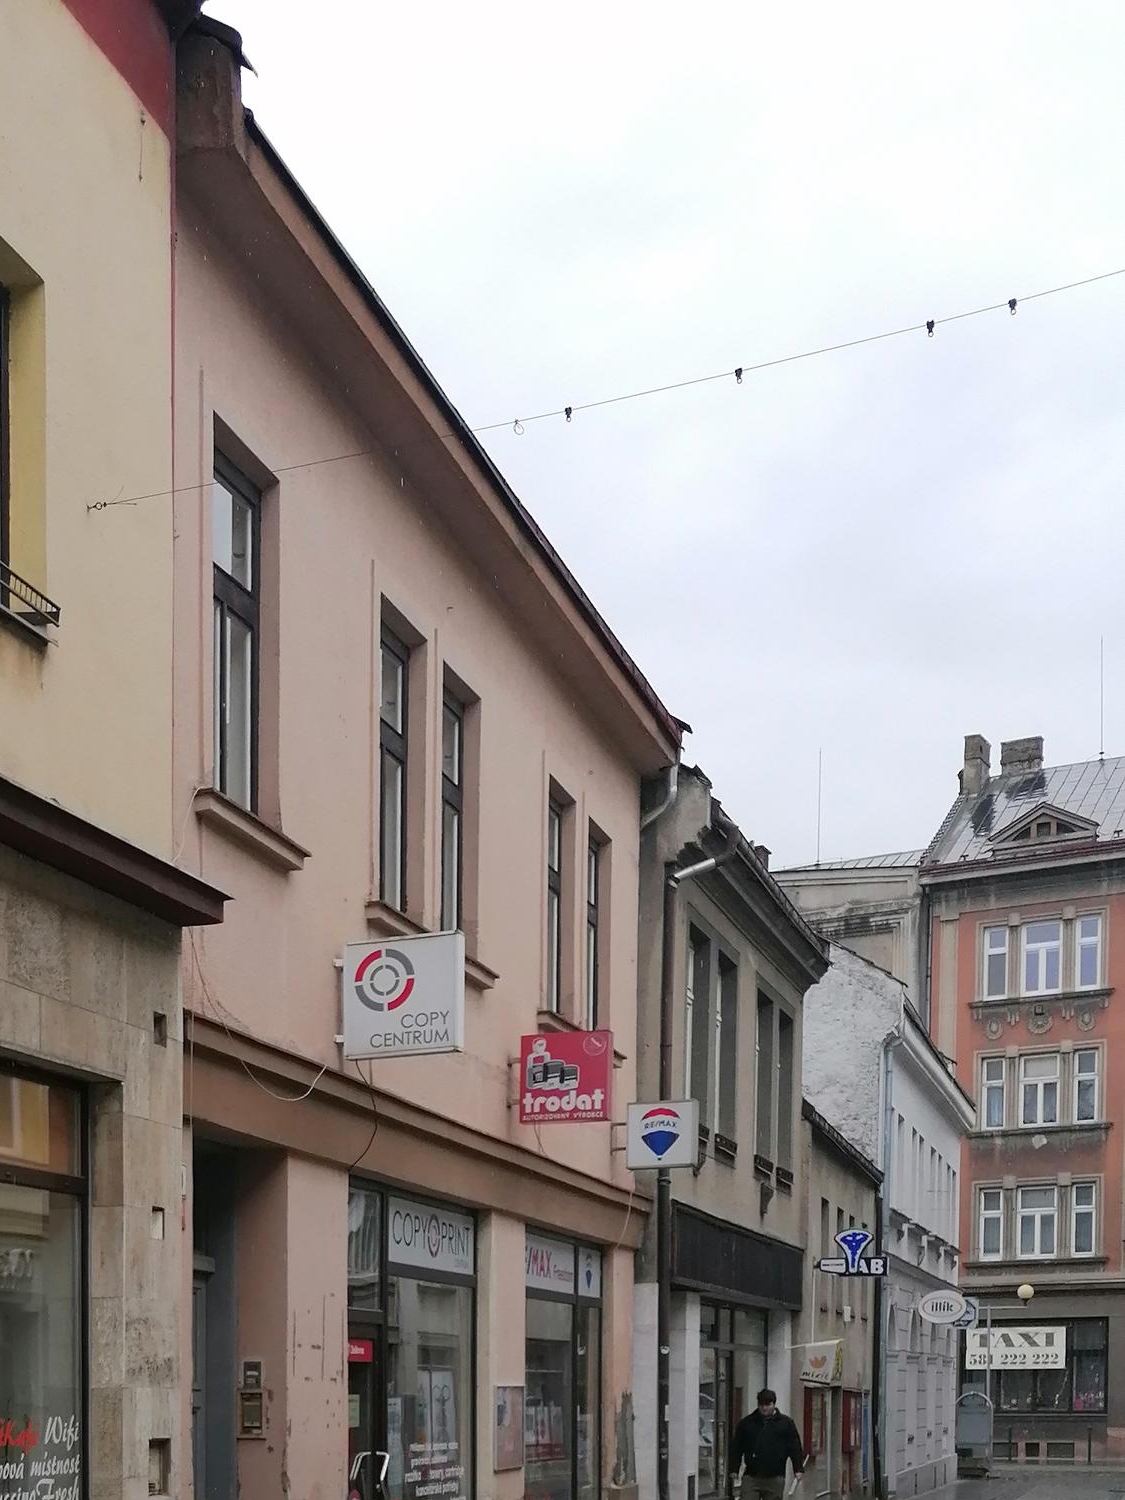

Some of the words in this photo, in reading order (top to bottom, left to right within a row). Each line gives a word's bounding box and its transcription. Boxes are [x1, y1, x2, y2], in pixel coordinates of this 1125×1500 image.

[401, 1010, 449, 1028] COPY
[370, 1028, 449, 1048] CENTRUM
[523, 1089, 604, 1113] trodat
[644, 1120, 677, 1129] RE/MAX
[392, 1210, 428, 1249] COPY
[441, 1222, 471, 1257] PRINT
[525, 1246, 552, 1279] /MAX
[973, 1332, 1055, 1347] TAXI
[1001, 1353, 1026, 1364] 222
[1033, 1353, 1058, 1364] 222
[44, 1414, 79, 1451] Wifi
[30, 1451, 80, 1477] místnost
